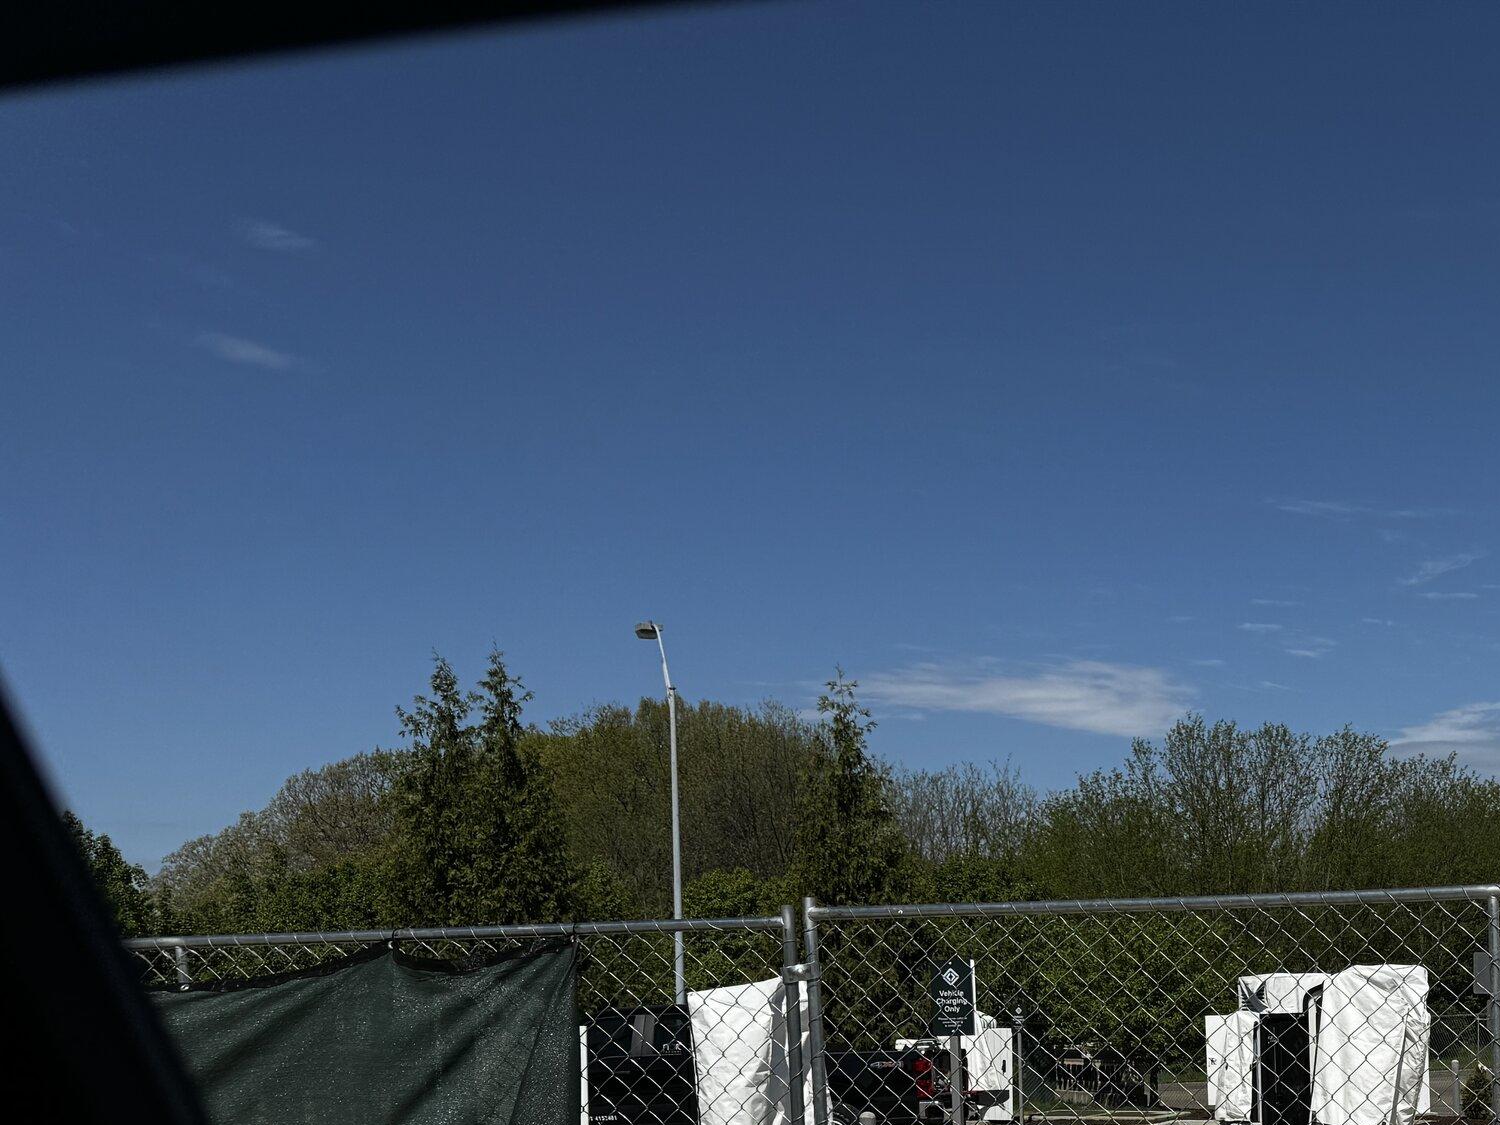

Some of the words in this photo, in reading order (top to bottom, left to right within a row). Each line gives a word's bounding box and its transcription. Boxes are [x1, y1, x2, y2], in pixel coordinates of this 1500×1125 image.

[938, 989, 965, 997] Vehicle
[936, 997, 967, 1006] Charging
[944, 1005, 961, 1013] Only
